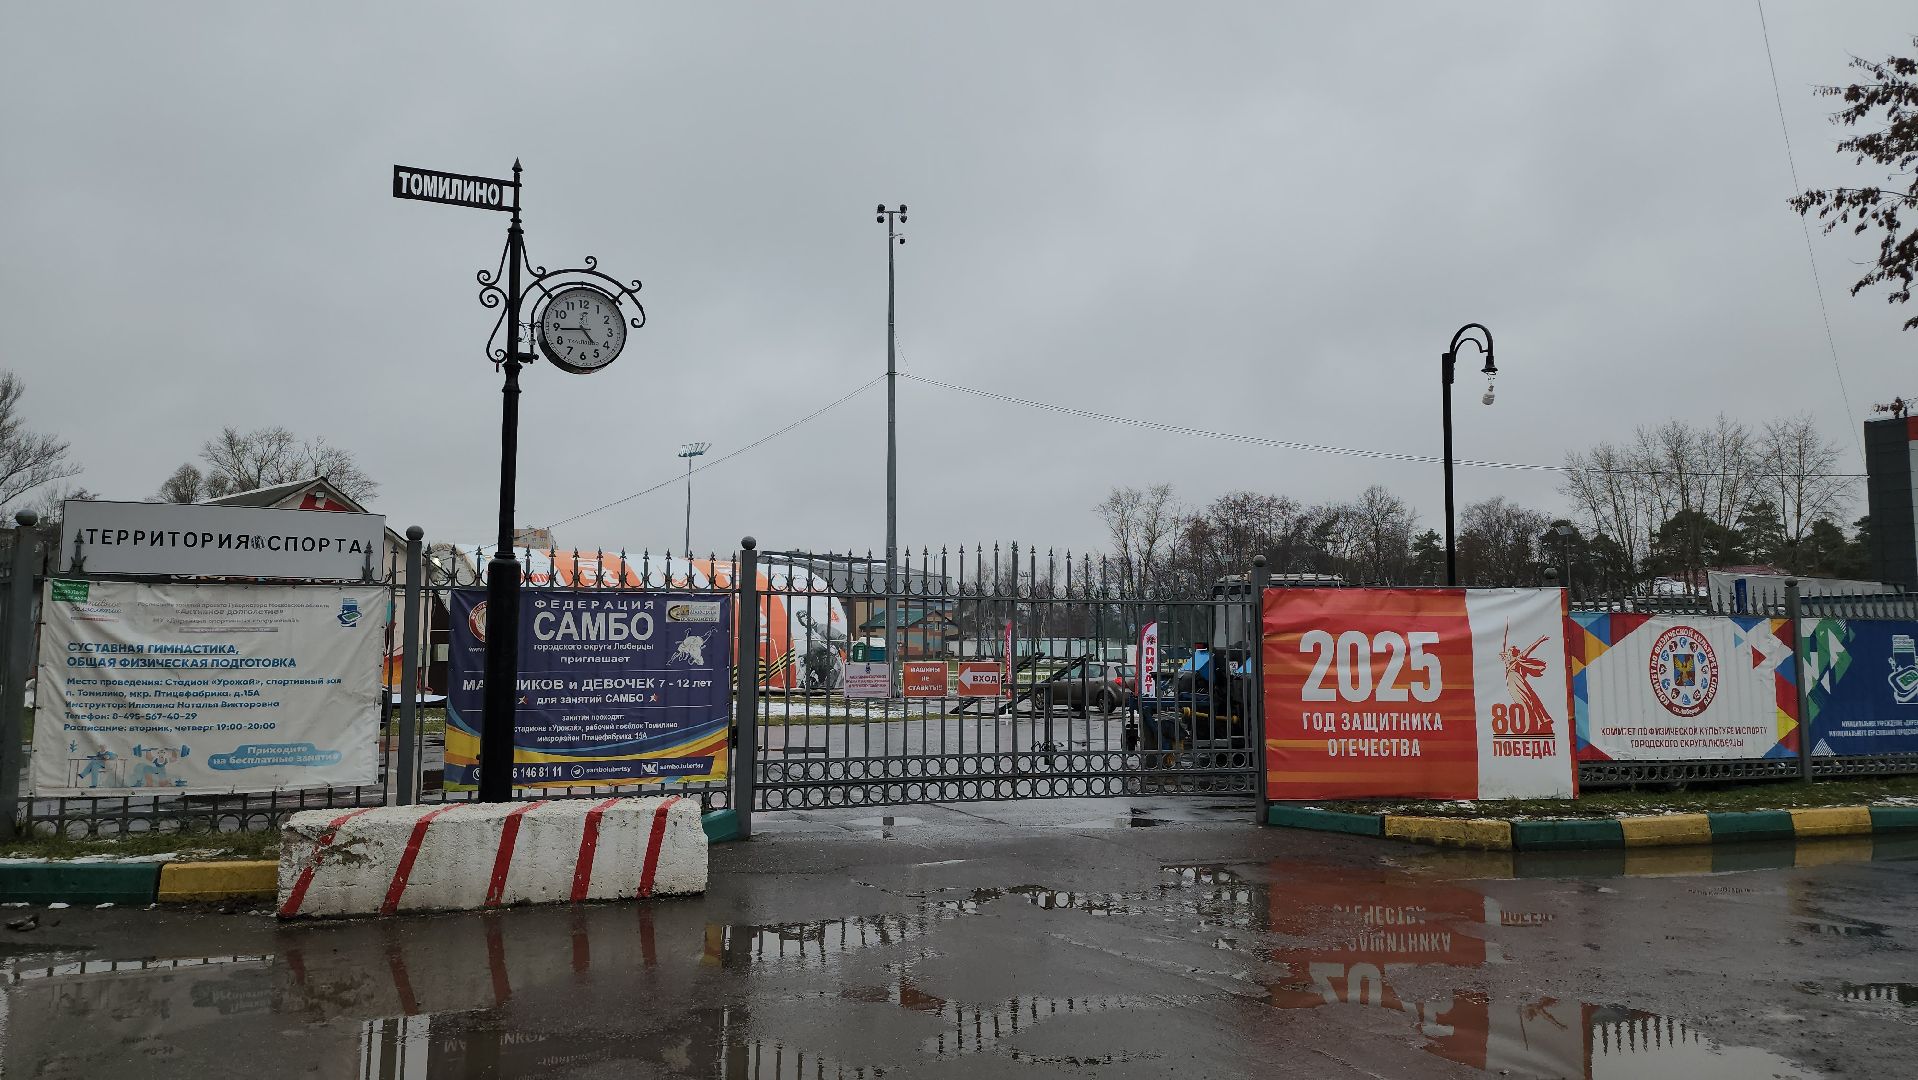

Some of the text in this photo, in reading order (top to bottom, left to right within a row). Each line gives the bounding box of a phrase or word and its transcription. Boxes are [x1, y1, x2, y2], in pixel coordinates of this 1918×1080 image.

[398, 171, 500, 206] ТОМИЛИНО
[565, 301, 575, 311] 11
[578, 299, 590, 310] 12
[595, 304, 600, 315] 1
[554, 309, 567, 320] 10
[603, 315, 610, 325] 2
[552, 322, 560, 332] 9
[606, 327, 614, 338] 3
[556, 335, 564, 346] 8
[602, 340, 610, 350] 4
[566, 345, 574, 356] 7
[579, 351, 587, 361] 6
[592, 348, 600, 359] 5
[85, 528, 363, 554] ТЕРРИТОРИЯ СПОРТА
[534, 599, 654, 611] ФЕДЕРАЦИЯ
[533, 611, 654, 641] САМБО
[1654, 628, 1694, 654] ФИЗИЧЕСКОЙ
[67, 642, 240, 655] СУСТАВНАЯ ГИМНАСТИКА,
[533, 642, 654, 652] городского округа Люберцы
[1694, 633, 1716, 668] КУЛЬТУРЕ
[67, 656, 297, 670] ОБЩАЯ ФИЗИЧЕСКАЯ ПОДГОТОВКА
[560, 655, 631, 665] приглашает
[1650, 655, 1658, 667] ПО
[1299, 629, 1443, 703] 2025
[67, 677, 98, 686] Место
[100, 679, 163, 688] проведения:
[164, 678, 209, 687] Стадион
[211, 678, 264, 688] «Урожай»,
[266, 677, 324, 687] спортивный
[568, 681, 578, 690] и
[581, 677, 655, 692] ДЕВОЧЕК
[658, 679, 666, 688] 7
[676, 678, 690, 688] 12
[692, 680, 713, 688] лет
[972, 675, 998, 684] ВХОД
[1650, 668, 1670, 706] КОМИТЕТ
[77, 689, 127, 699] Томилино,
[129, 690, 152, 699] мкр.
[537, 693, 644, 705] для занятий САМБО
[65, 700, 127, 710] Инструктор:
[176, 701, 219, 709] Наталья
[220, 700, 280, 709] Викторовна
[65, 711, 198, 720] Телефон: 8-495-567-40-29
[1491, 703, 1526, 734] 80
[1302, 712, 1443, 733] ГОД ЗАЩИТНИКА
[63, 723, 127, 733] Расписание:
[129, 724, 173, 734] вторник,
[174, 724, 214, 733] четверг
[1600, 727, 1636, 736] КОМИТЕТ
[1638, 727, 1648, 735] ПО
[1649, 726, 1698, 735] ФИЗИЧЕСКОЙ
[1700, 727, 1734, 735] КУЛЬТУРЕ
[1742, 726, 1768, 735] СПОРТУ
[1327, 738, 1421, 757] ОТЕЧЕСТВА
[1631, 739, 1679, 748] ГОРОДСКОГО
[1680, 739, 1707, 748] ОКРУГА
[247, 745, 308, 756] Приходите
[1493, 740, 1557, 760] ПОБЕДА!
[229, 756, 294, 764] бесплатные
[296, 753, 340, 762] занятия
[520, 766, 537, 778] 146
[538, 766, 549, 778] 81
[552, 765, 562, 777] 11
